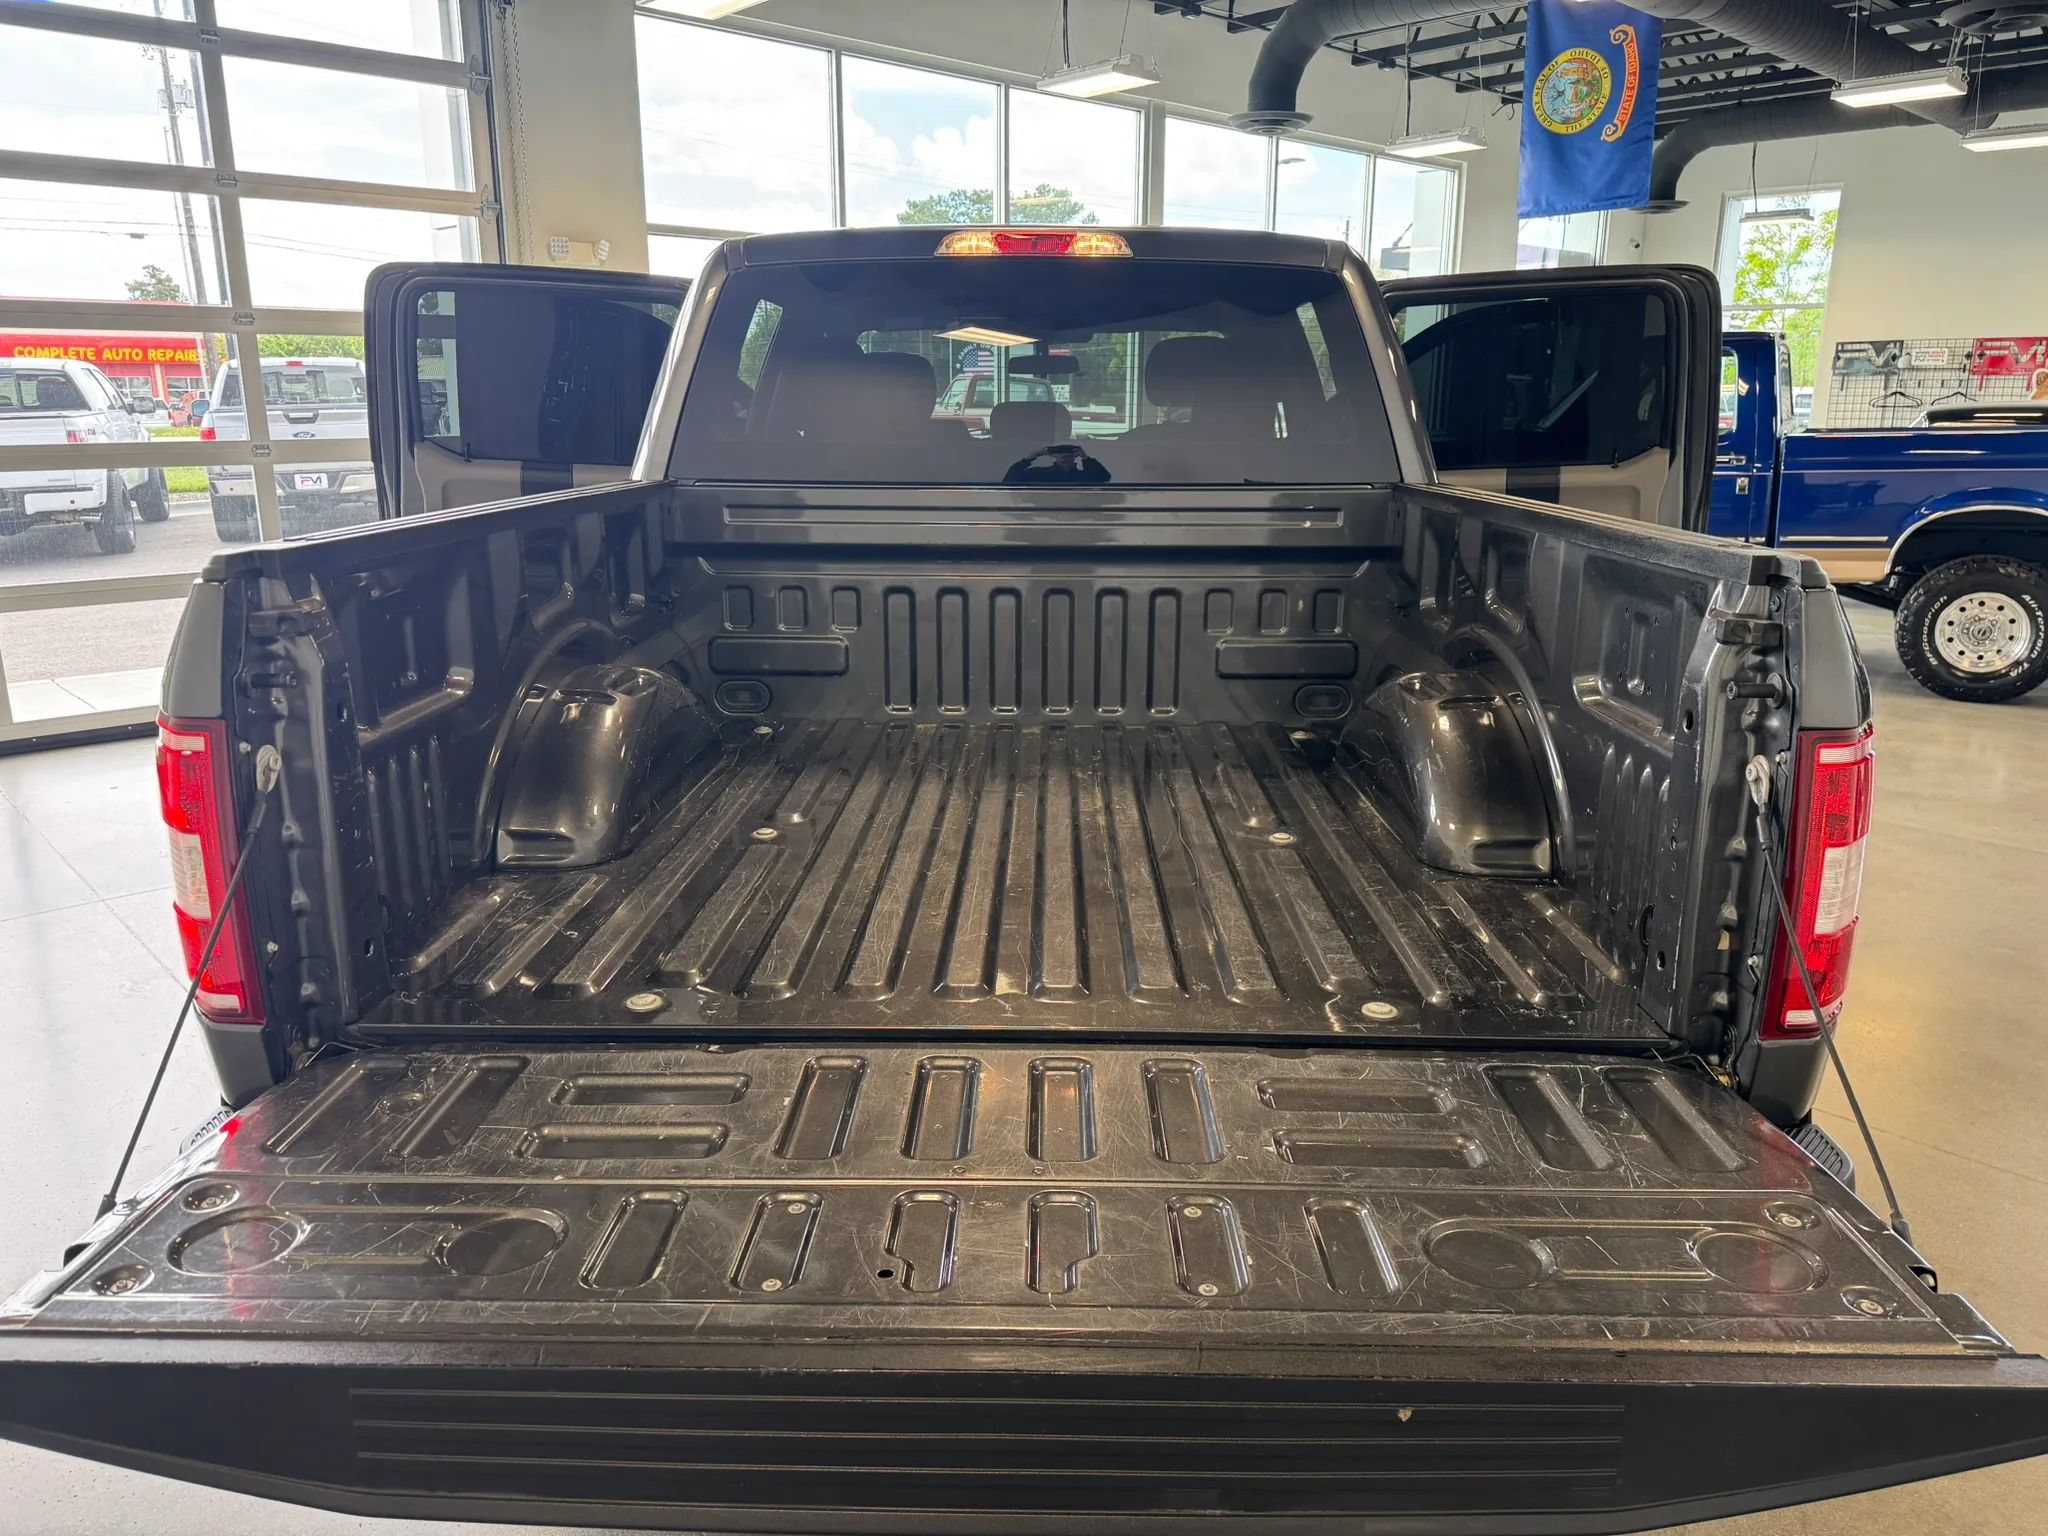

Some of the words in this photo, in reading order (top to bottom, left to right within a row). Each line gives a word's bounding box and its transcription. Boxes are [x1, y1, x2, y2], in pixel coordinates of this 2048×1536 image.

[1569, 50, 1601, 65] IDAHO
[1626, 42, 1638, 72] IDAHO
[1548, 60, 1559, 71] OF
[1601, 66, 1609, 80] OF
[1534, 73, 1547, 97] SEAL
[1627, 72, 1637, 87] OF
[1586, 92, 1608, 122] STATE
[1618, 89, 1634, 121] STATE
[1534, 101, 1553, 128] GREAT
[1564, 120, 1584, 132] THE
[13, 345, 96, 361] COMPLETE
[102, 347, 143, 362] AUTO
[147, 348, 198, 362] REPAIR
[300, 476, 322, 485] FM
